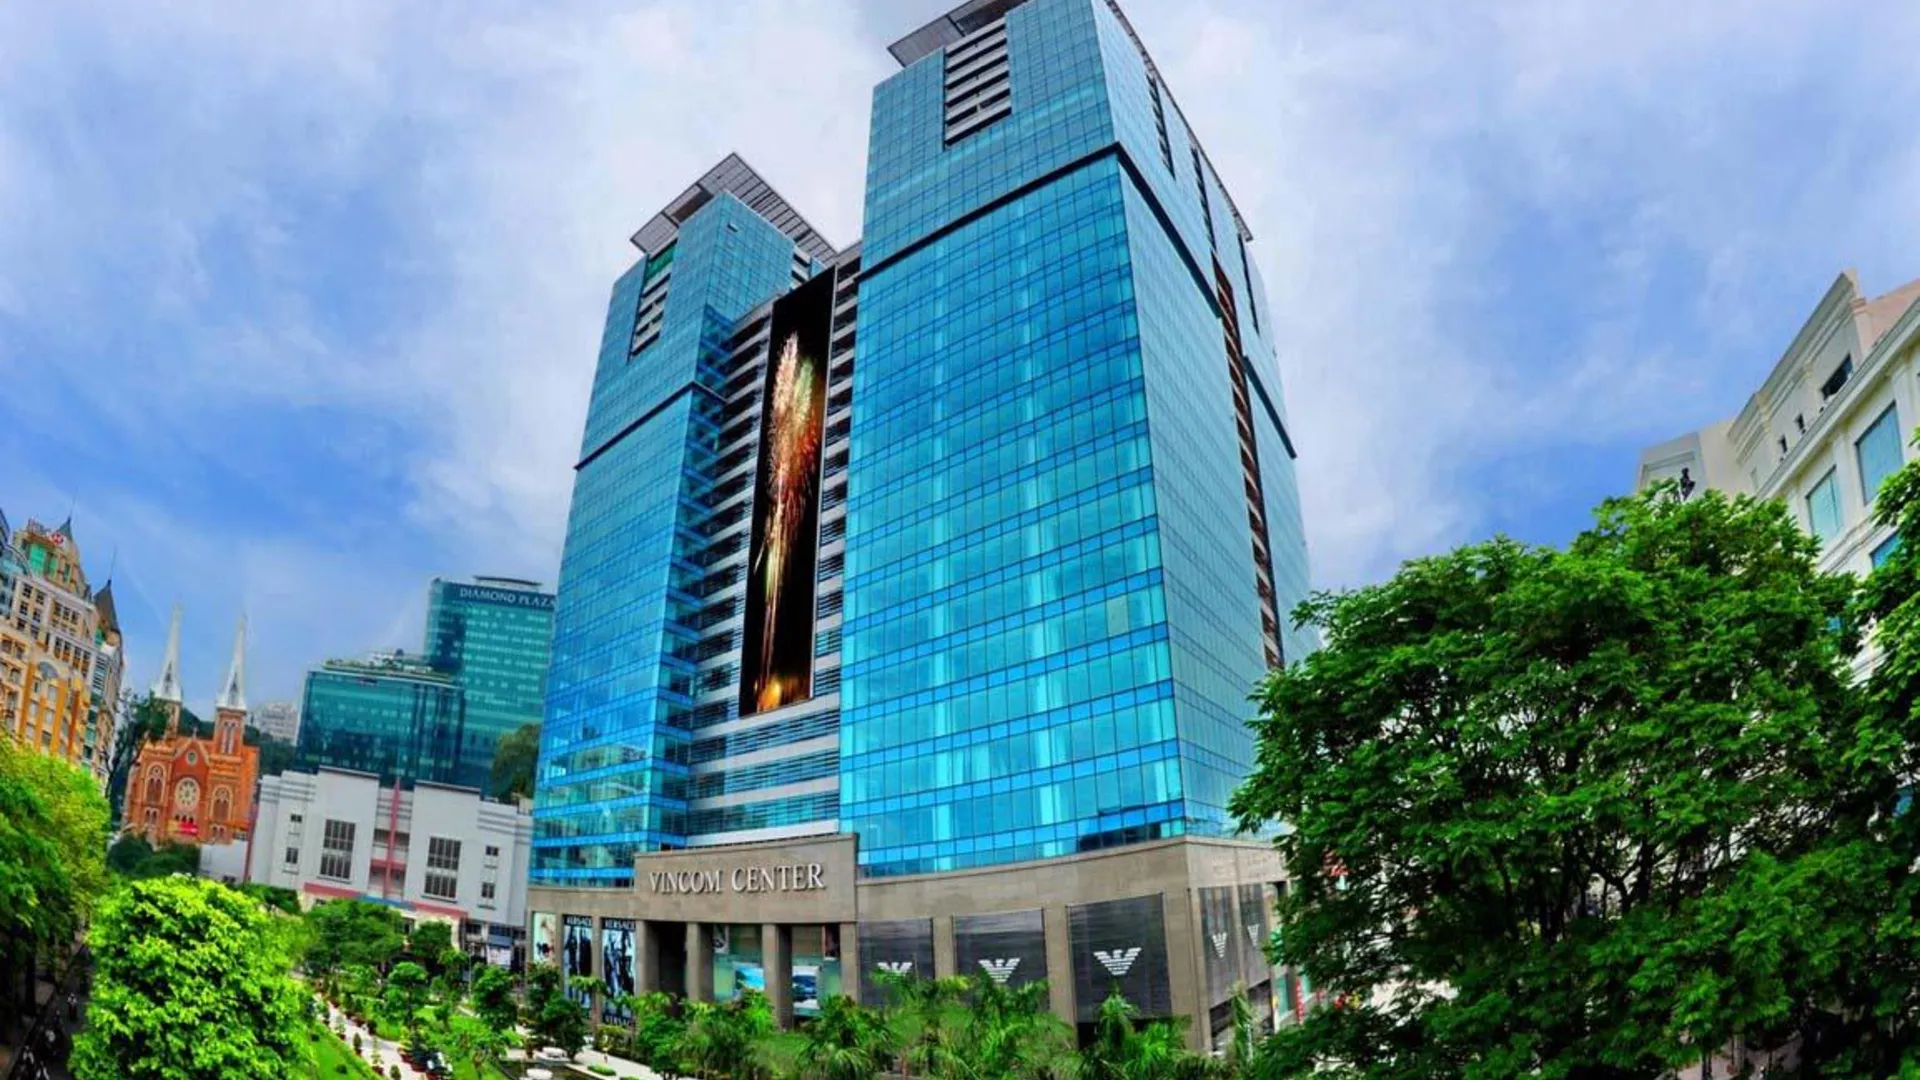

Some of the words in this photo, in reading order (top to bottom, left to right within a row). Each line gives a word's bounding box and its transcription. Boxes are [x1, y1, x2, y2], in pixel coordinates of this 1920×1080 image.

[460, 588, 516, 603] DIAMOND
[650, 870, 722, 894] VINCOM
[731, 863, 825, 892] CENTER
